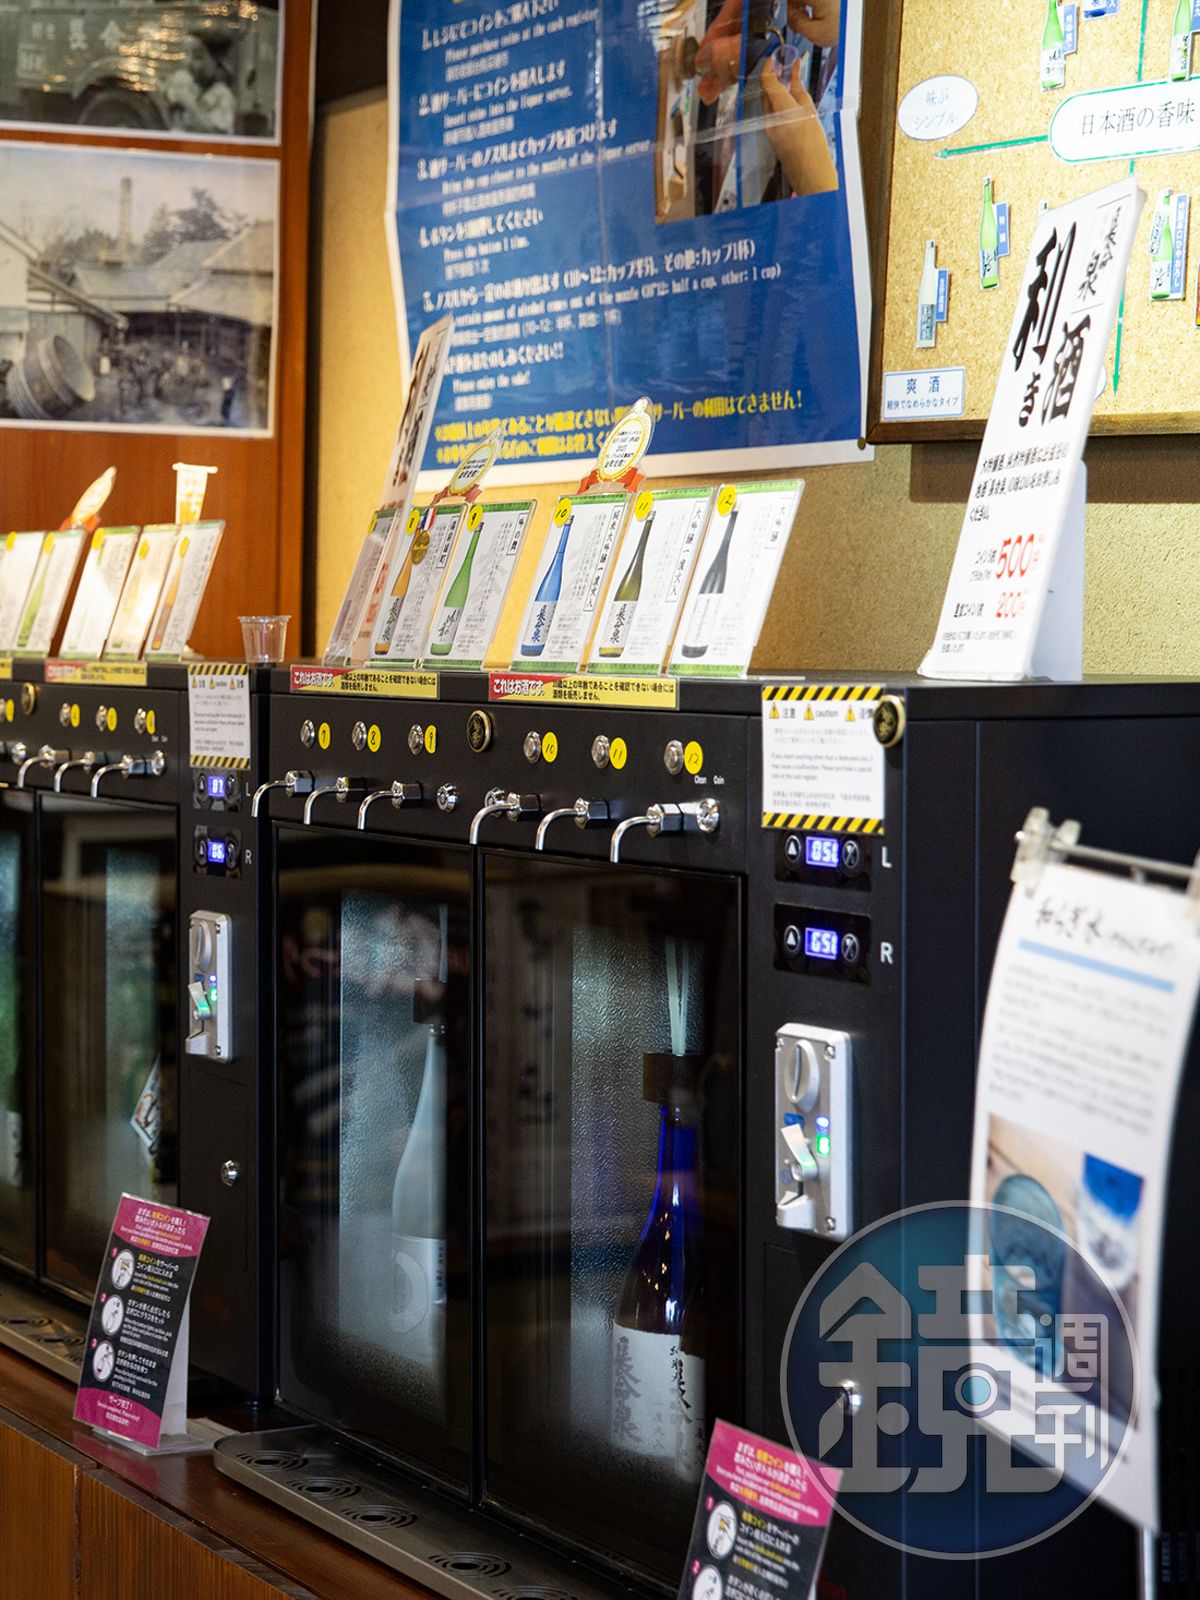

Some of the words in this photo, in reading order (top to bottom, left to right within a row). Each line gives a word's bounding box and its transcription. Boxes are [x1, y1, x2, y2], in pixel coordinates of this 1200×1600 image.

[493, 678, 545, 697] これはお酒です。
[244, 850, 252, 865] R
[881, 846, 893, 868] L
[880, 942, 894, 965] R
